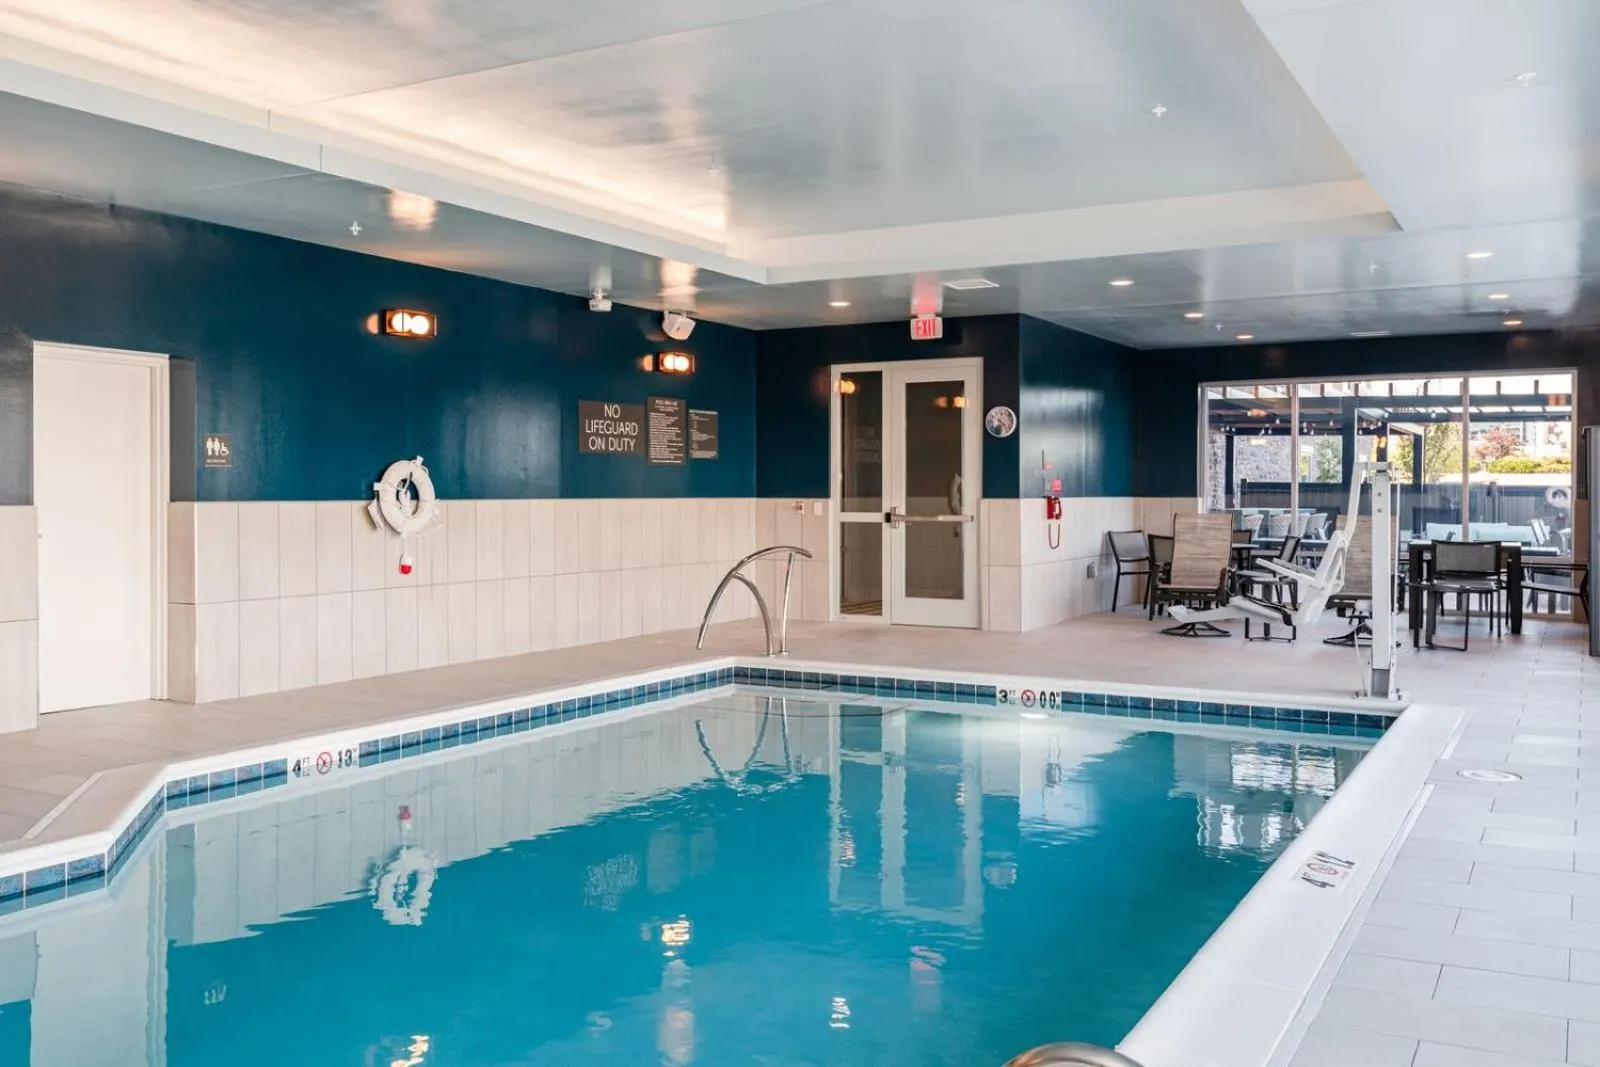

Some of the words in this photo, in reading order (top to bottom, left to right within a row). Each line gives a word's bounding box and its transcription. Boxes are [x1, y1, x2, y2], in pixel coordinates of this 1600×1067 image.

[915, 319, 936, 337] EXIT
[604, 404, 621, 419] NO
[585, 419, 639, 436] LIFEGUARD
[588, 436, 606, 450] ON
[608, 437, 636, 452] DUTY
